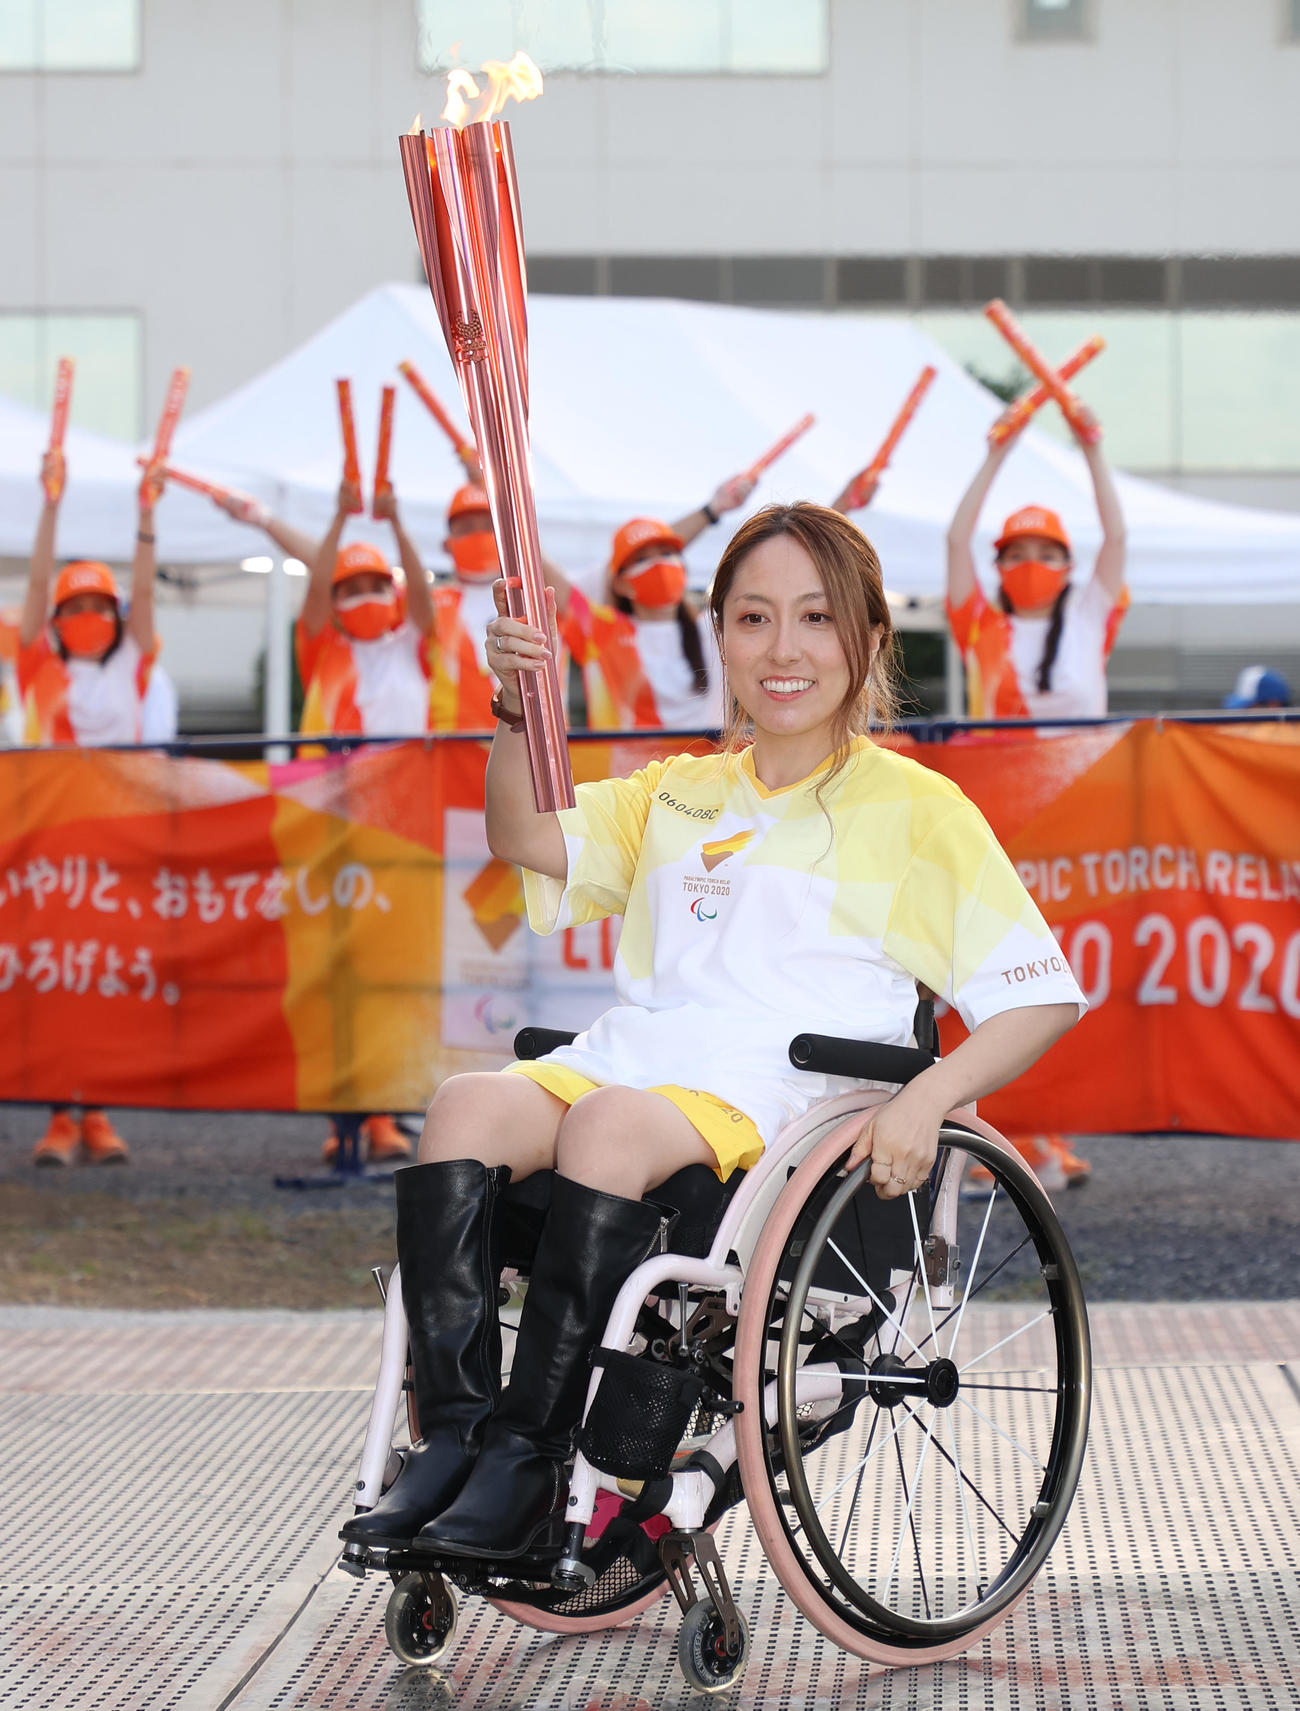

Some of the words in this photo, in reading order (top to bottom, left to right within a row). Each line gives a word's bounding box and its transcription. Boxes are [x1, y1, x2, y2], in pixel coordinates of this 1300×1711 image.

[659, 792, 719, 820] 060408C
[1080, 844, 1200, 898] TORCH
[683, 882, 709, 894] TOKYO
[711, 885, 730, 896] 2020
[1001, 957, 1061, 984] TOKYO
